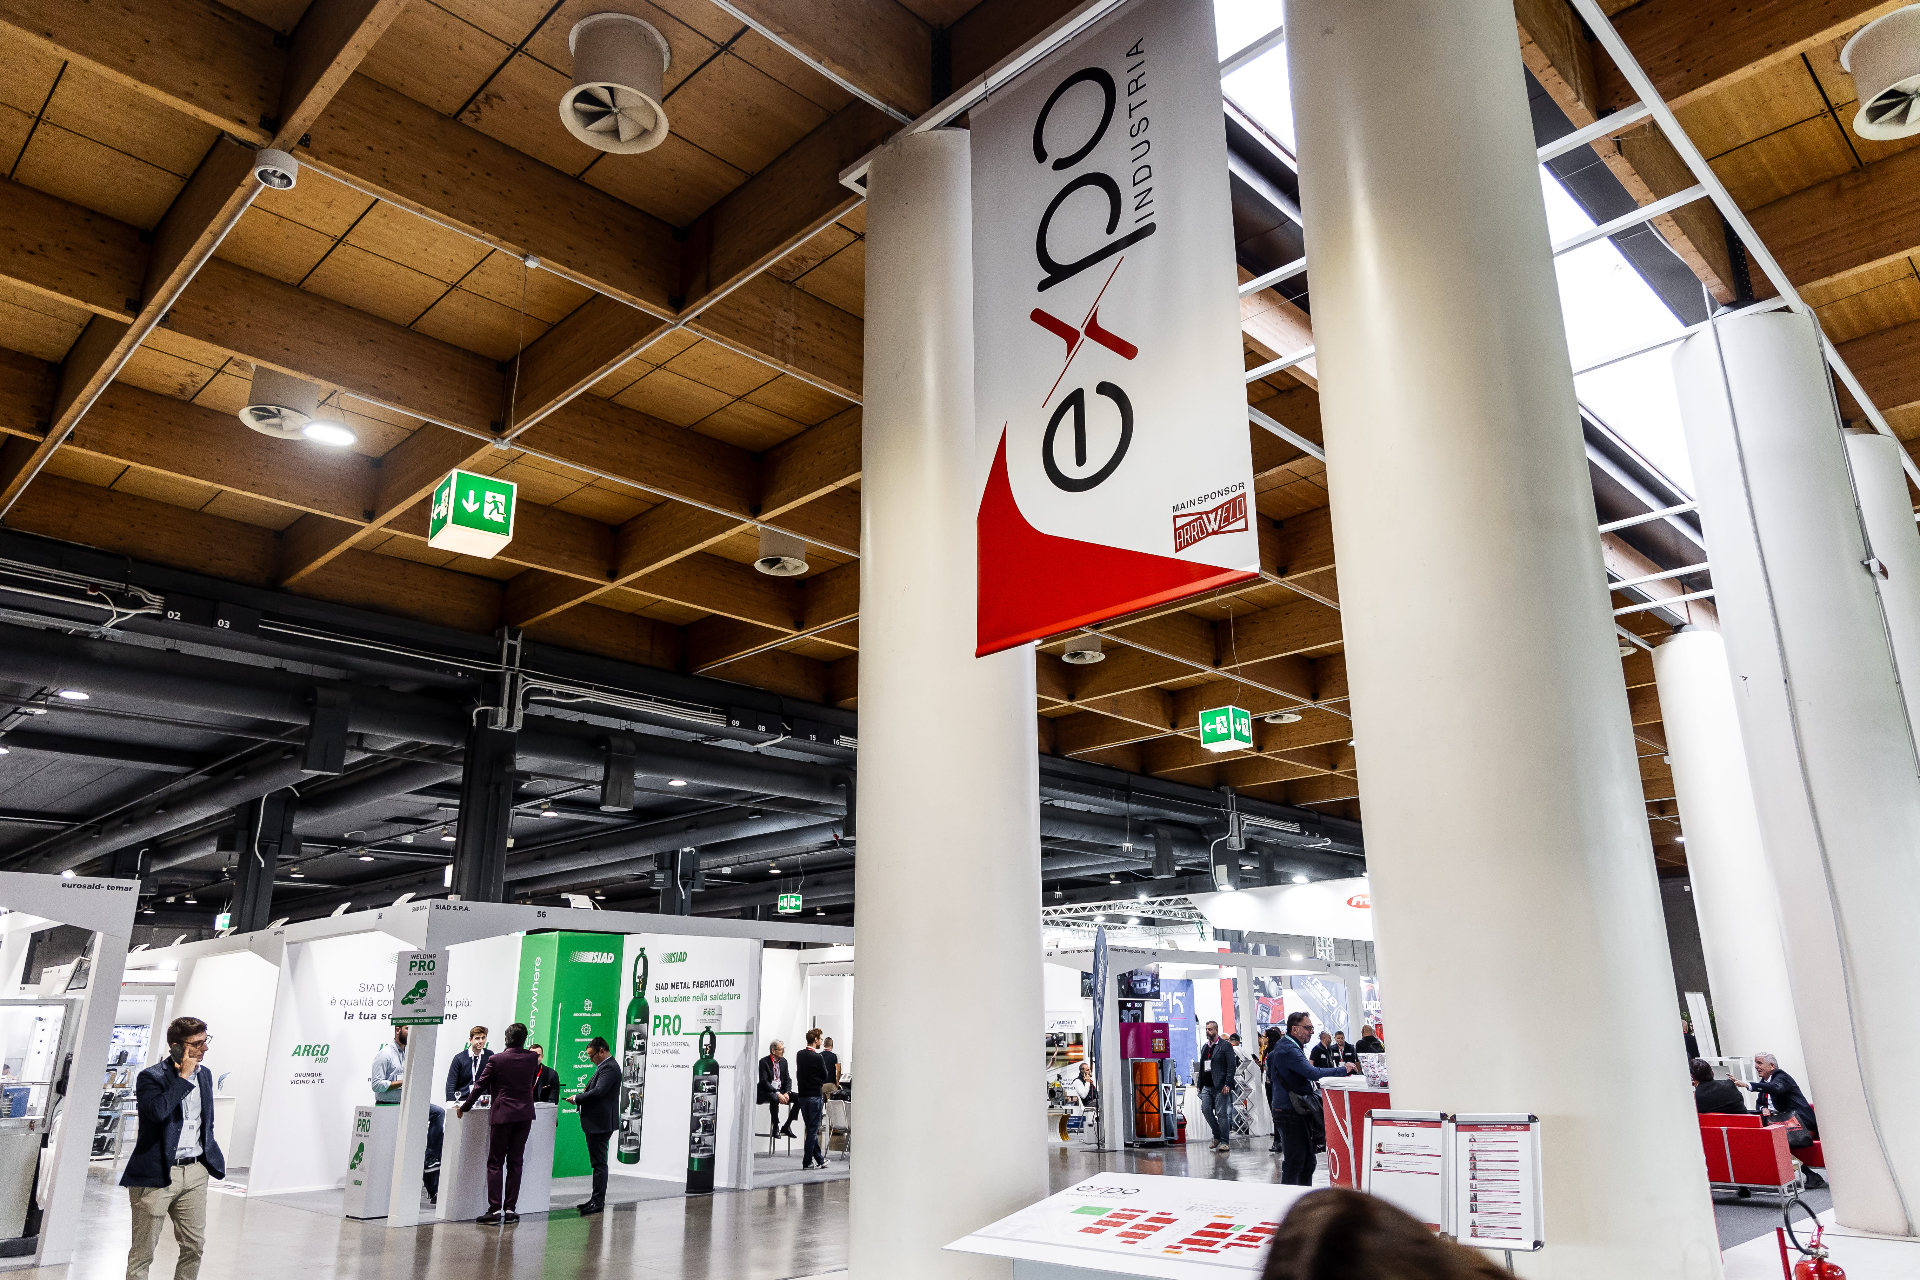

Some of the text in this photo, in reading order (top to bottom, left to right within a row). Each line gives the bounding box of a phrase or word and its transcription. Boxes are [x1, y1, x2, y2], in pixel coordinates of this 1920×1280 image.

[1127, 36, 1156, 224] INDUSTRIA
[1030, 66, 1157, 493] expo
[1172, 482, 1245, 513] MAIN SPONSOR
[1176, 497, 1245, 550] ARROWELD
[167, 610, 181, 620] 02
[217, 619, 230, 629] 03
[731, 719, 740, 727] 09
[757, 724, 766, 732] 08
[833, 738, 840, 746] 16
[106, 884, 134, 892] temar
[536, 910, 547, 919] 56
[592, 951, 615, 964] SIAD
[671, 951, 688, 963] SIAD
[409, 960, 436, 972] PRO
[358, 983, 385, 993] SIAD
[655, 978, 735, 991] SIAD METAL FABRICATION
[330, 996, 337, 1006] è
[340, 996, 374, 1008] qualità
[526, 956, 542, 1048] Everywhere
[654, 991, 741, 1003] la soluzione nella saldatura
[343, 1011, 355, 1020] la
[358, 1012, 377, 1020] tua
[652, 1014, 682, 1036] PRO
[291, 1043, 331, 1057] ARGO
[356, 1118, 371, 1133] PRO
